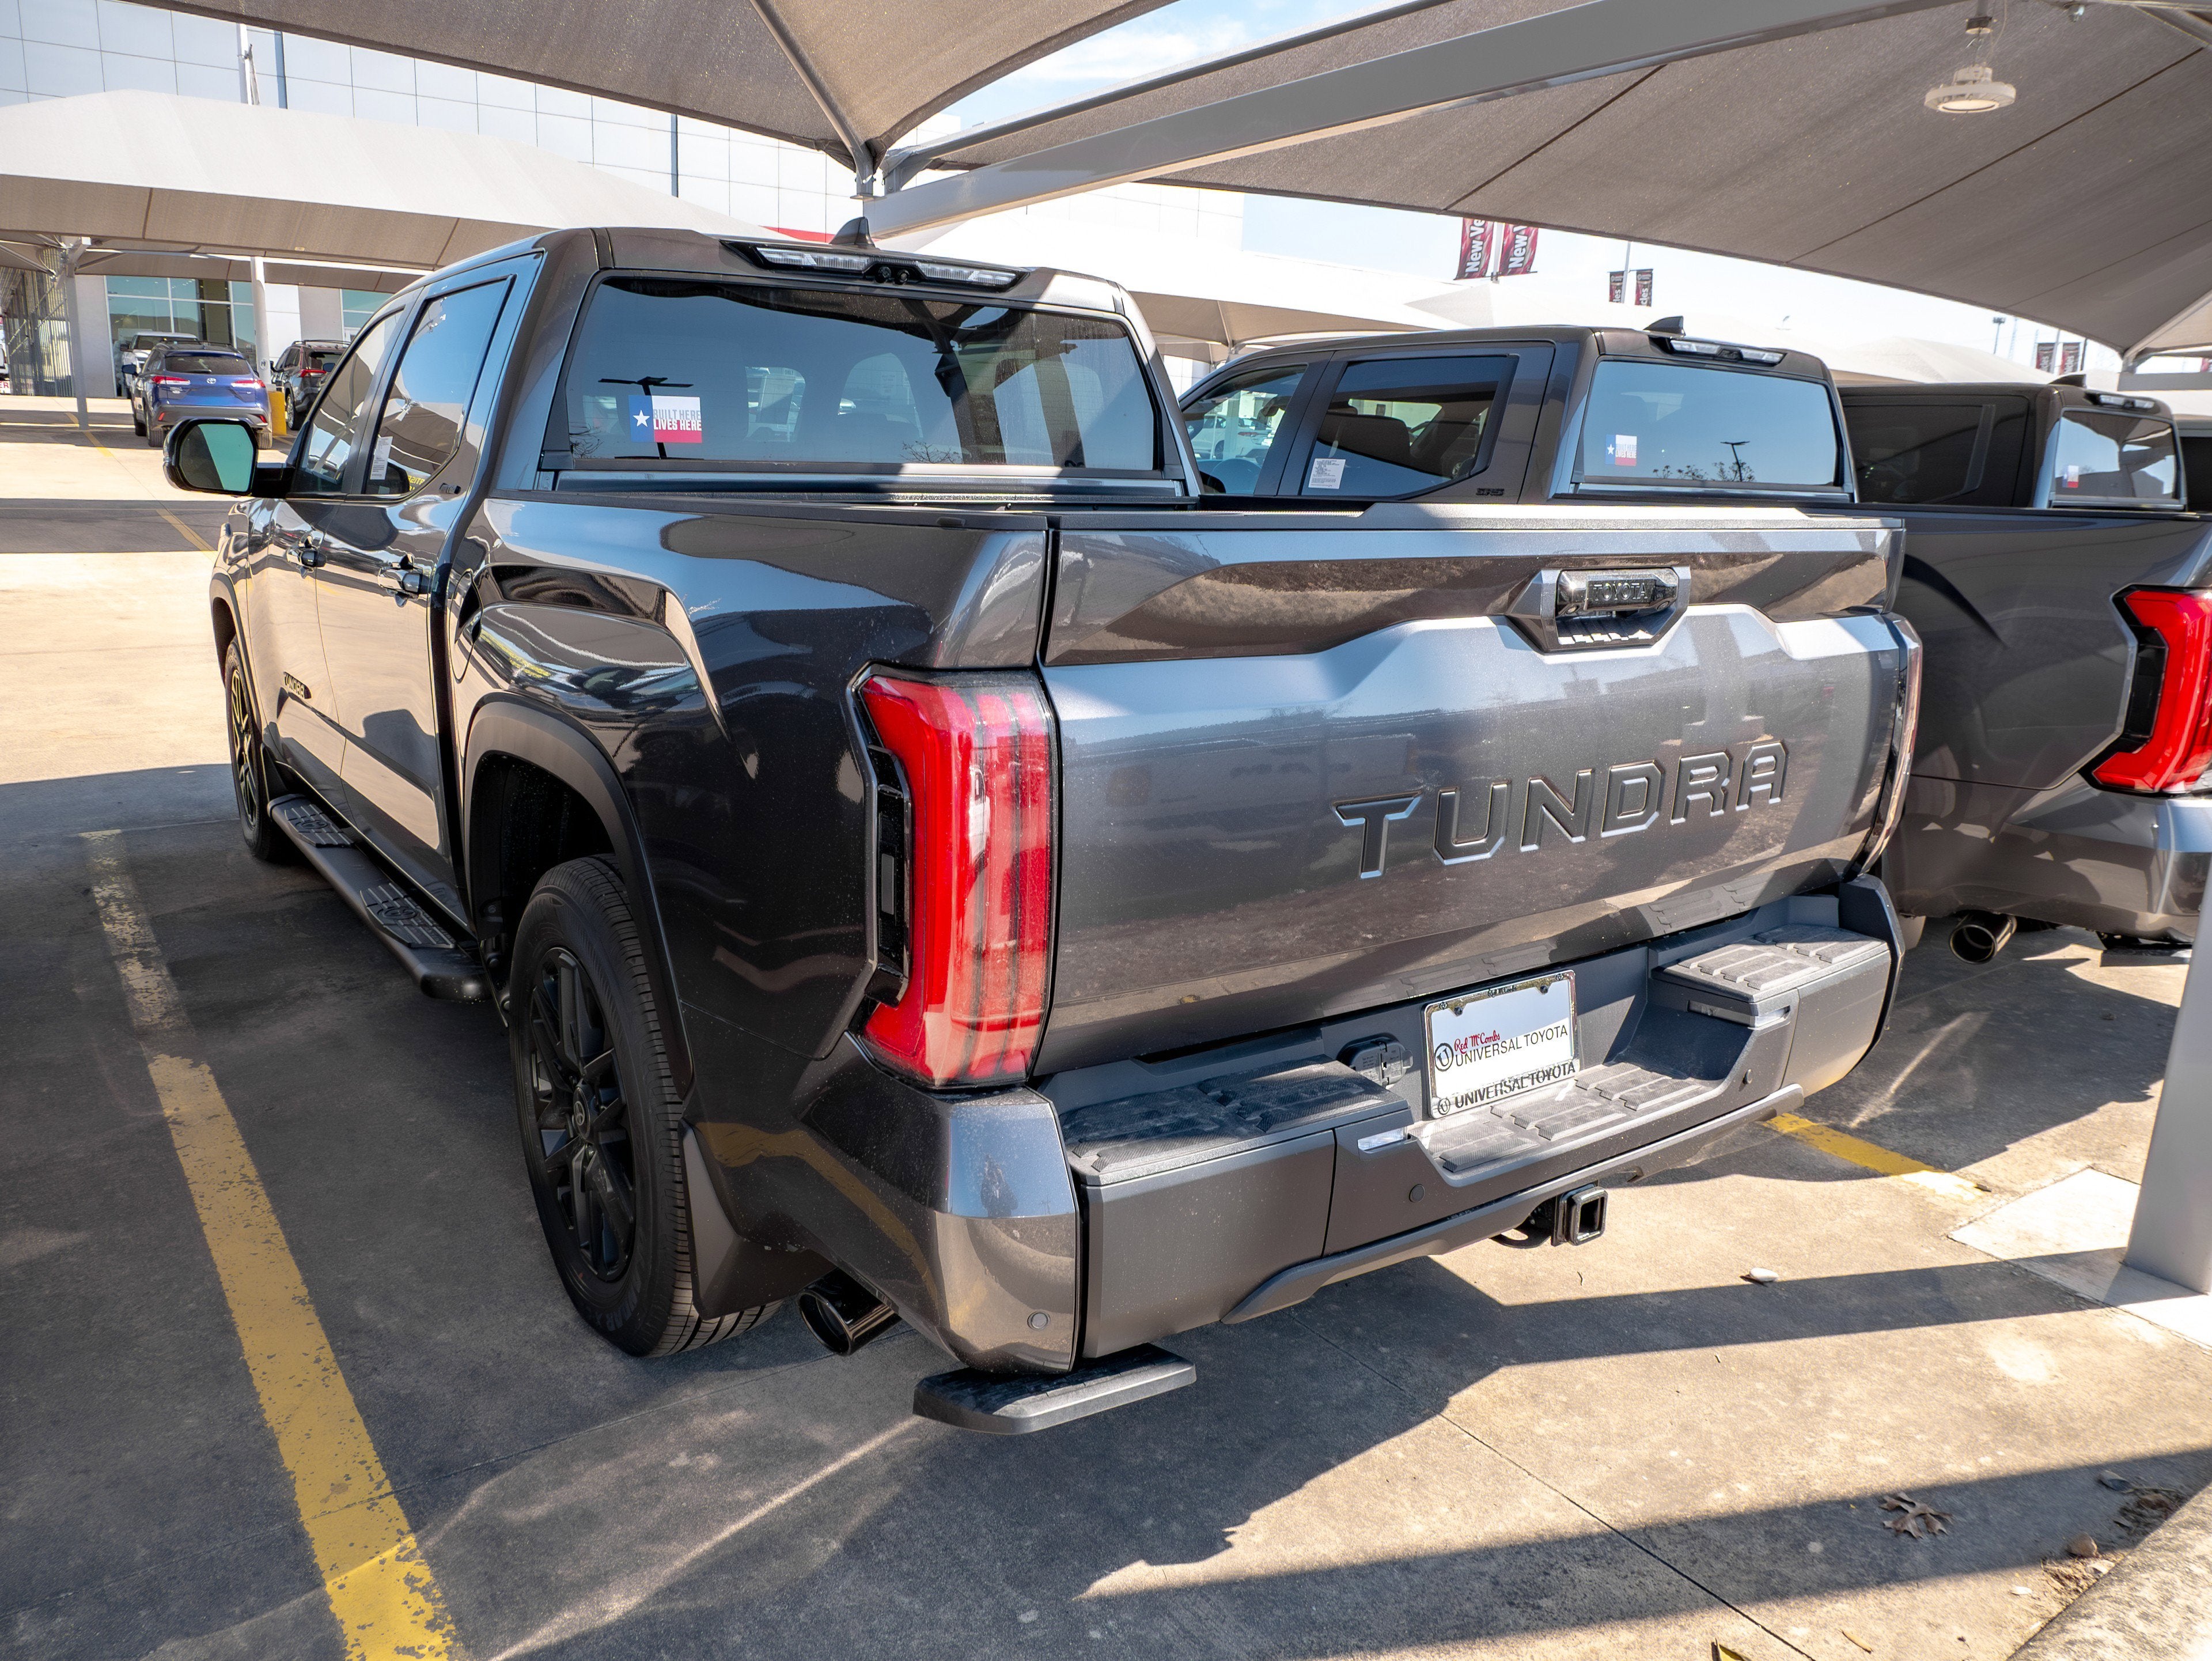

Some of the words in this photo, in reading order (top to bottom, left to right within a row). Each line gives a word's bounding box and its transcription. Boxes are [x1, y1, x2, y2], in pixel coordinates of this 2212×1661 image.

[1465, 240, 1483, 273] New
[1508, 234, 1528, 268] New
[653, 409, 677, 420] BUILT
[679, 410, 701, 421] HERE
[654, 419, 678, 430] LIVES
[679, 419, 702, 431] HERE
[1593, 582, 1648, 601] TOYOTA
[1331, 739, 1789, 879] TUNDRA
[1454, 1037, 1468, 1054] Red
[1469, 1030, 1501, 1047] McCombs
[1455, 1036, 1522, 1067] UNIVERSAL
[1524, 1024, 1568, 1047] TOYOTA
[1455, 1076, 1529, 1109] UNIVERSAL
[1529, 1062, 1575, 1086] TOYOTA
